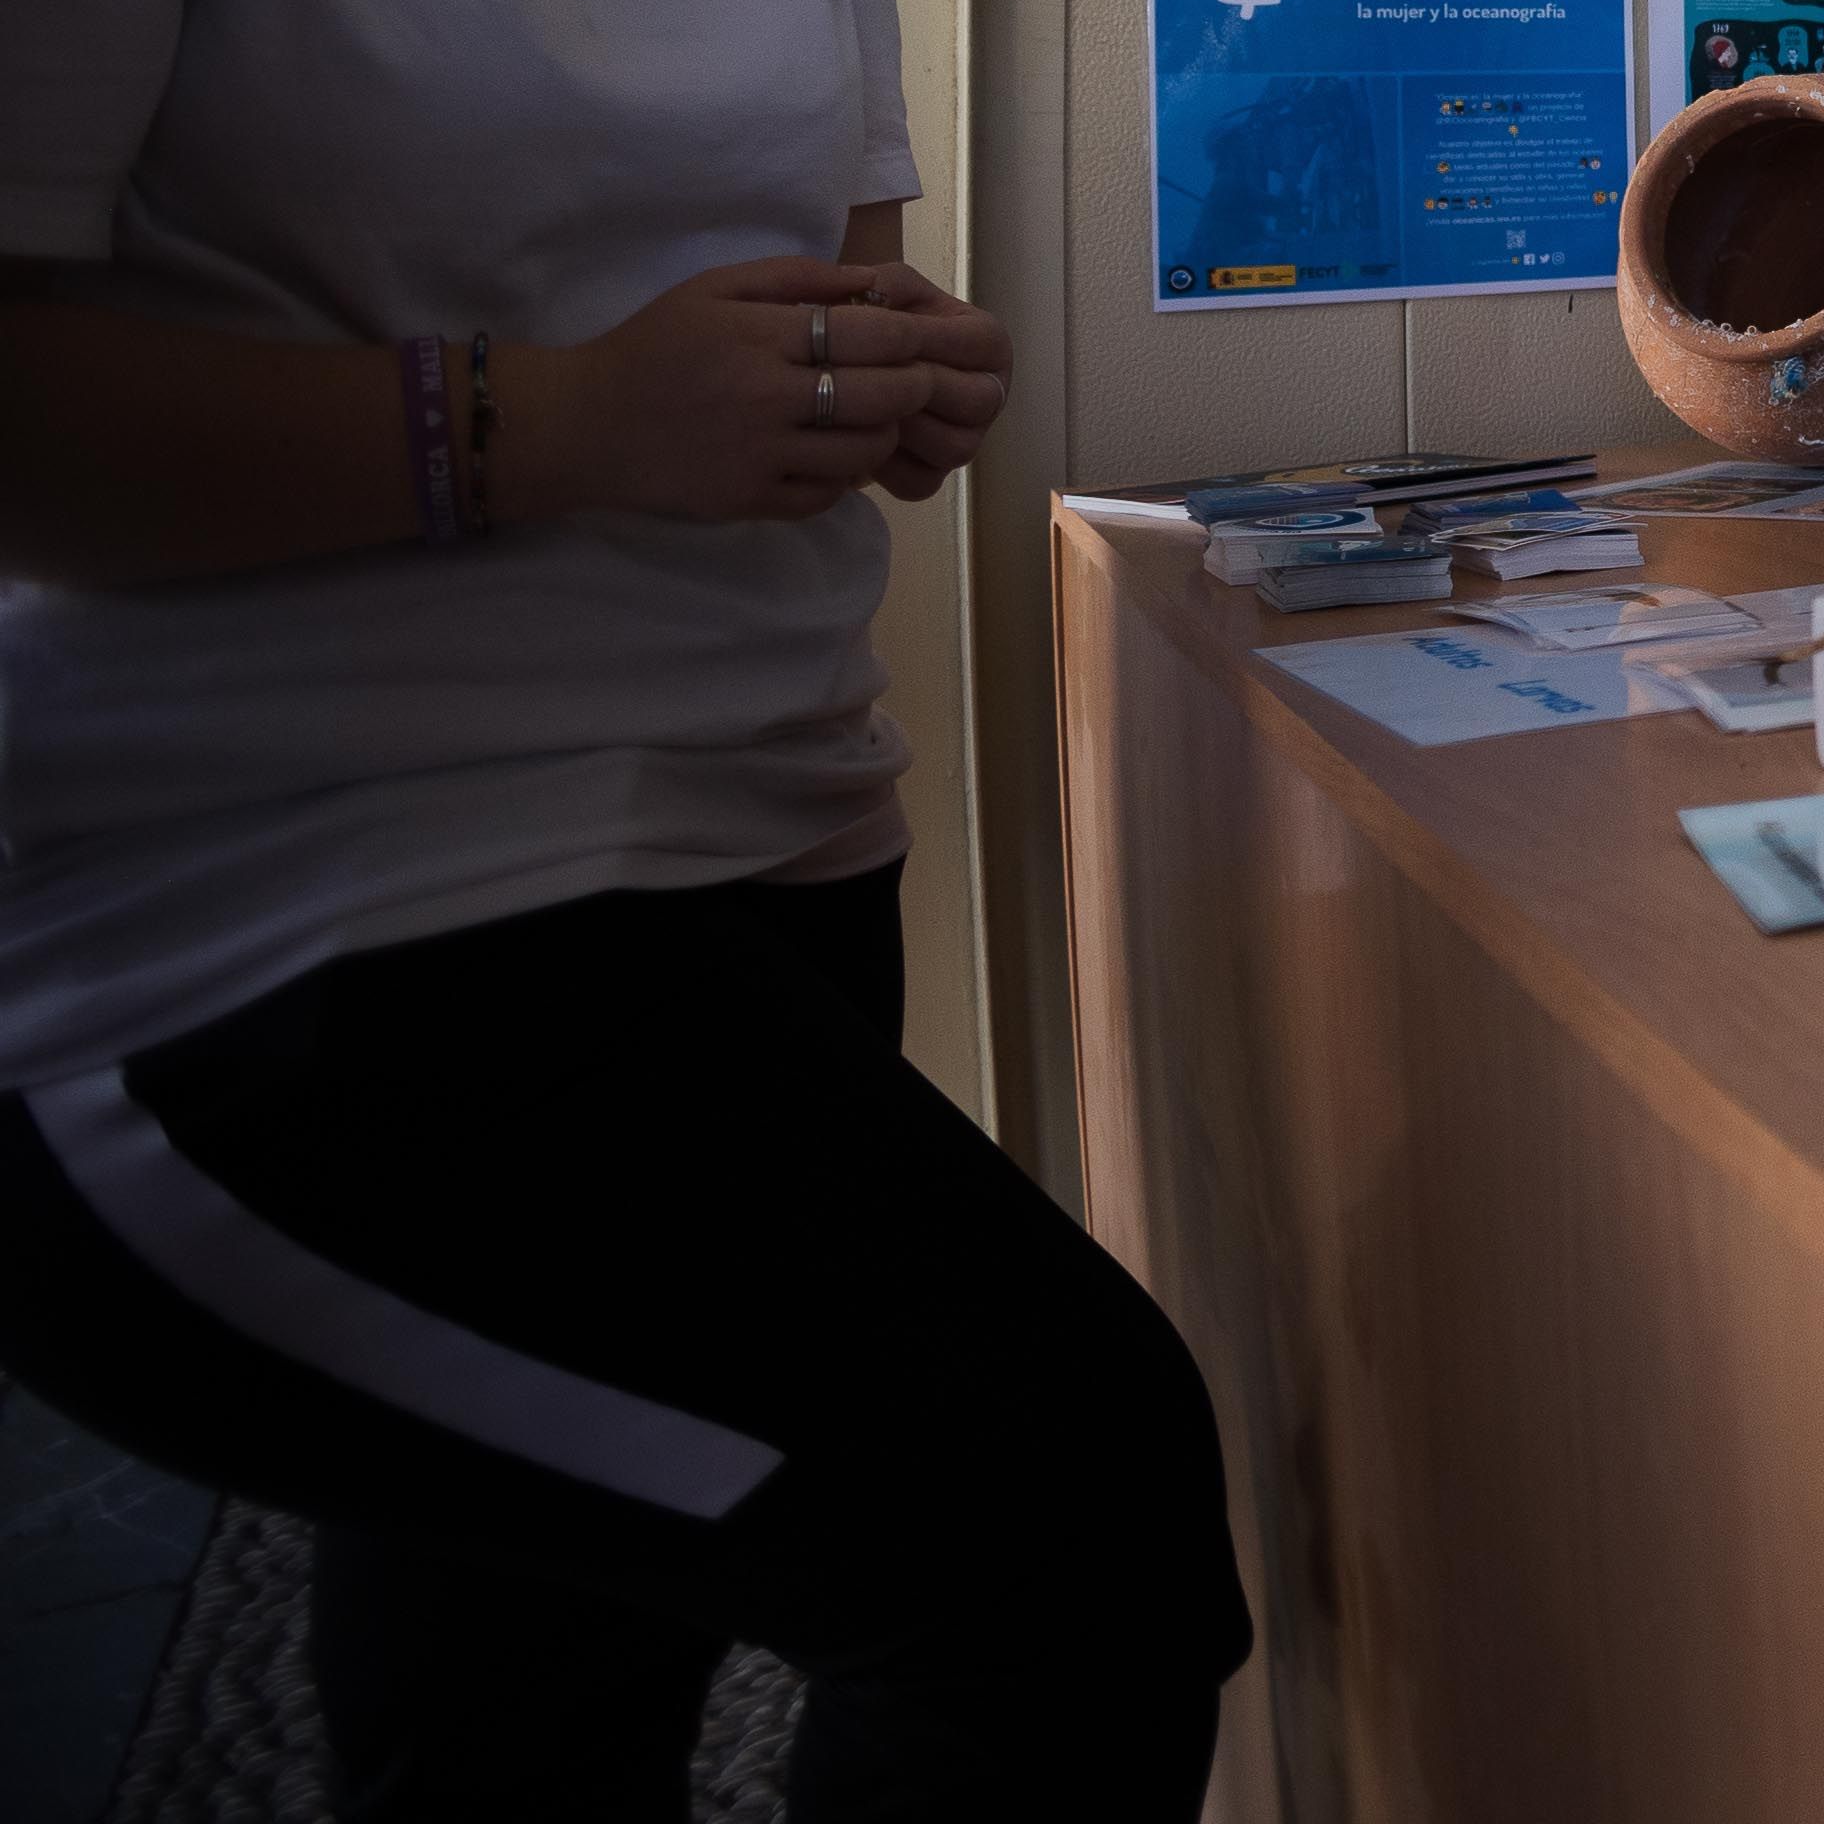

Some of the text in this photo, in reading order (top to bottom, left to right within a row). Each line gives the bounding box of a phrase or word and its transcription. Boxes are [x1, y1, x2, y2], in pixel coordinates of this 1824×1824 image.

[1357, 1, 1567, 25] la mujer y la oceanografía
[1402, 637, 1494, 670] Adultos
[1496, 679, 1597, 714] Larvas
